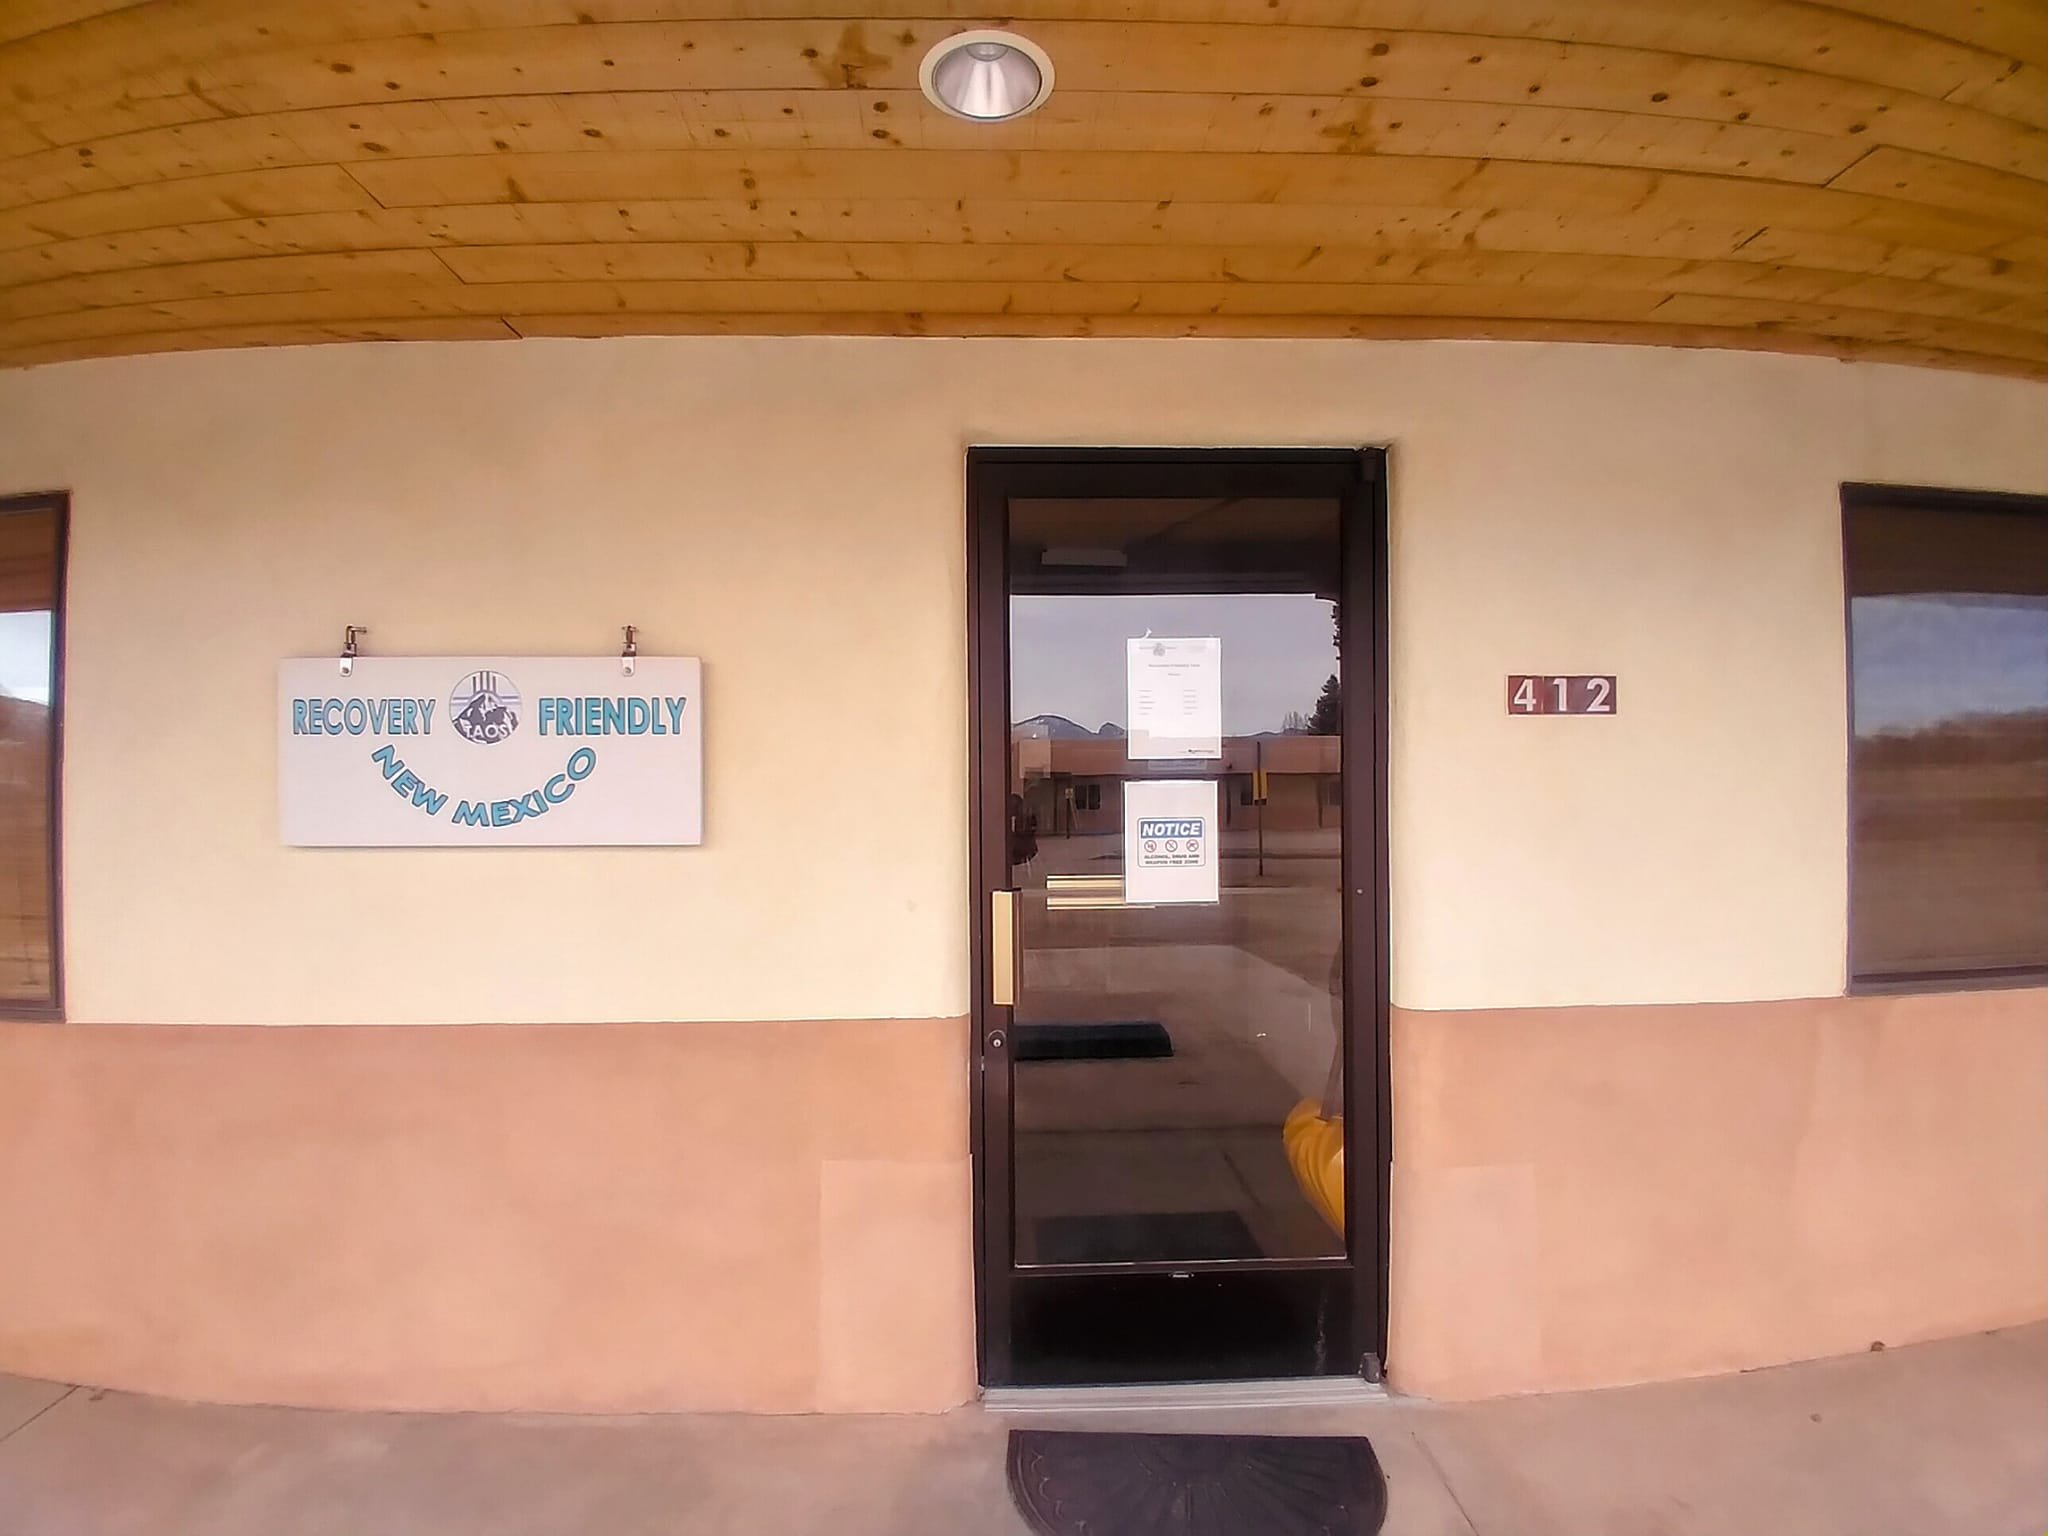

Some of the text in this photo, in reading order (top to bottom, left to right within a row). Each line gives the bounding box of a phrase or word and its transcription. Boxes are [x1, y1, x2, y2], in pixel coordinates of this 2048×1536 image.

[1513, 677, 1611, 712] 412
[292, 697, 687, 736] RECOVERY FRIENDLY
[465, 722, 509, 739] TAOS
[371, 744, 598, 828] NEW MEXICO
[1142, 822, 1202, 837] NOTICE
